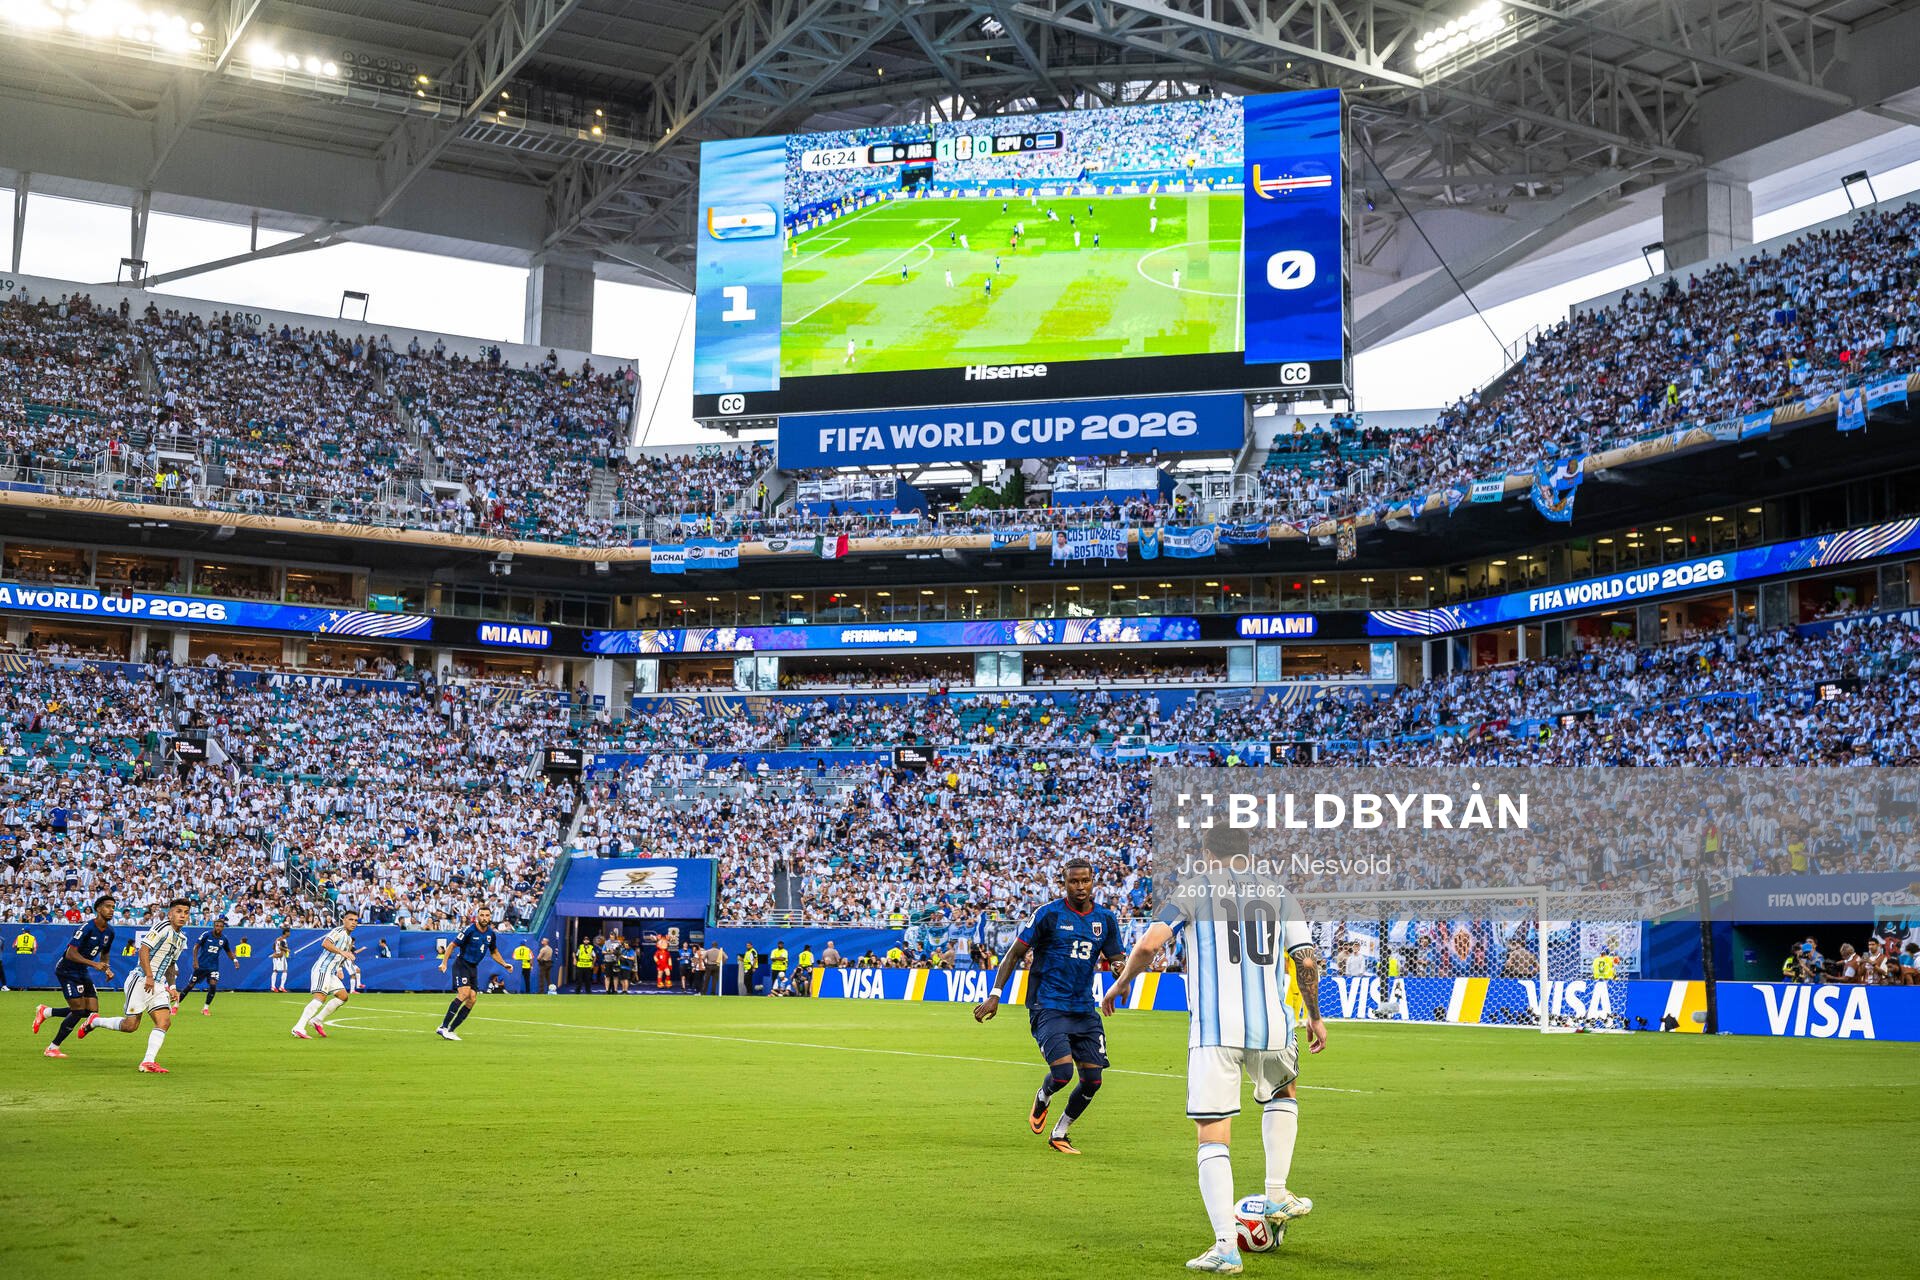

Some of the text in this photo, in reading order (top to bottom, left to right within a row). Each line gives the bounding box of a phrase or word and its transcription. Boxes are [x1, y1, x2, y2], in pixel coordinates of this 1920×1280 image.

[907, 136, 1022, 158] ARG 1 0 CPV
[811, 151, 857, 167] 46:24
[1266, 250, 1316, 291] 0
[722, 285, 756, 322] 1
[964, 362, 1047, 382] Hisense
[1284, 367, 1307, 381] CC
[722, 398, 742, 411] CC
[819, 410, 1198, 453] FIFA WORLD CUP 2026
[696, 445, 721, 457] 352
[1530, 559, 1725, 612] FIFA WORLD CUP 2026
[16, 588, 98, 610] WORLD
[102, 596, 146, 614] CUP
[150, 599, 225, 620] 2026
[481, 625, 548, 646] MIAMI
[841, 628, 917, 643] #FIFAWorldCup
[1241, 617, 1313, 635] MIAMI
[1768, 891, 1912, 907] FIFA WORLD CUP 202
[599, 905, 665, 918] MIAMI
[1219, 898, 1277, 966] 10
[208, 945, 219, 953] 22
[480, 944, 485, 953] 4
[1069, 940, 1093, 960] 13
[838, 969, 884, 999] VISA
[943, 970, 988, 1002] VISA
[1336, 977, 1410, 1020] VISA
[1518, 979, 1613, 1023] VISA
[1752, 984, 1876, 1039] VISA
